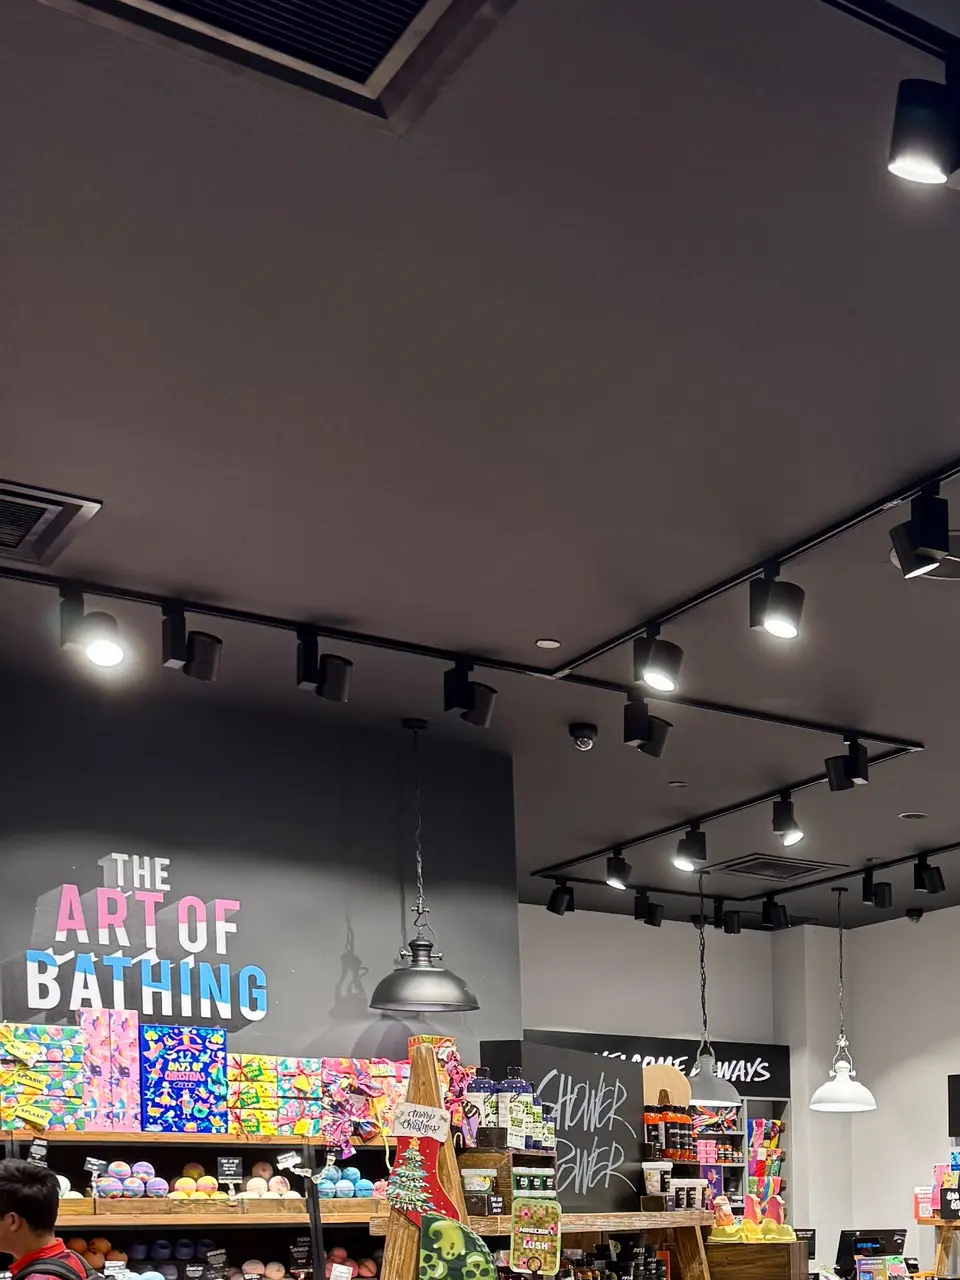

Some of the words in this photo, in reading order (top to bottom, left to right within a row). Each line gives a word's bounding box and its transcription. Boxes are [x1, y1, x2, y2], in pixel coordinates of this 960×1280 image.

[111, 852, 170, 892] THE
[55, 884, 164, 949] ART
[178, 896, 240, 955] OF
[26, 949, 268, 1021] BATHING
[168, 1061, 191, 1072] DAYS
[192, 1061, 204, 1072] OF
[178, 1050, 194, 1062] 12
[165, 1071, 206, 1082] CHRISTMAS
[690, 1058, 771, 1082] WAYS
[537, 1069, 637, 1138] SHOWER
[400, 1120, 440, 1136] Christmas
[556, 1136, 637, 1195] POWER
[523, 1240, 549, 1250] LUSH
